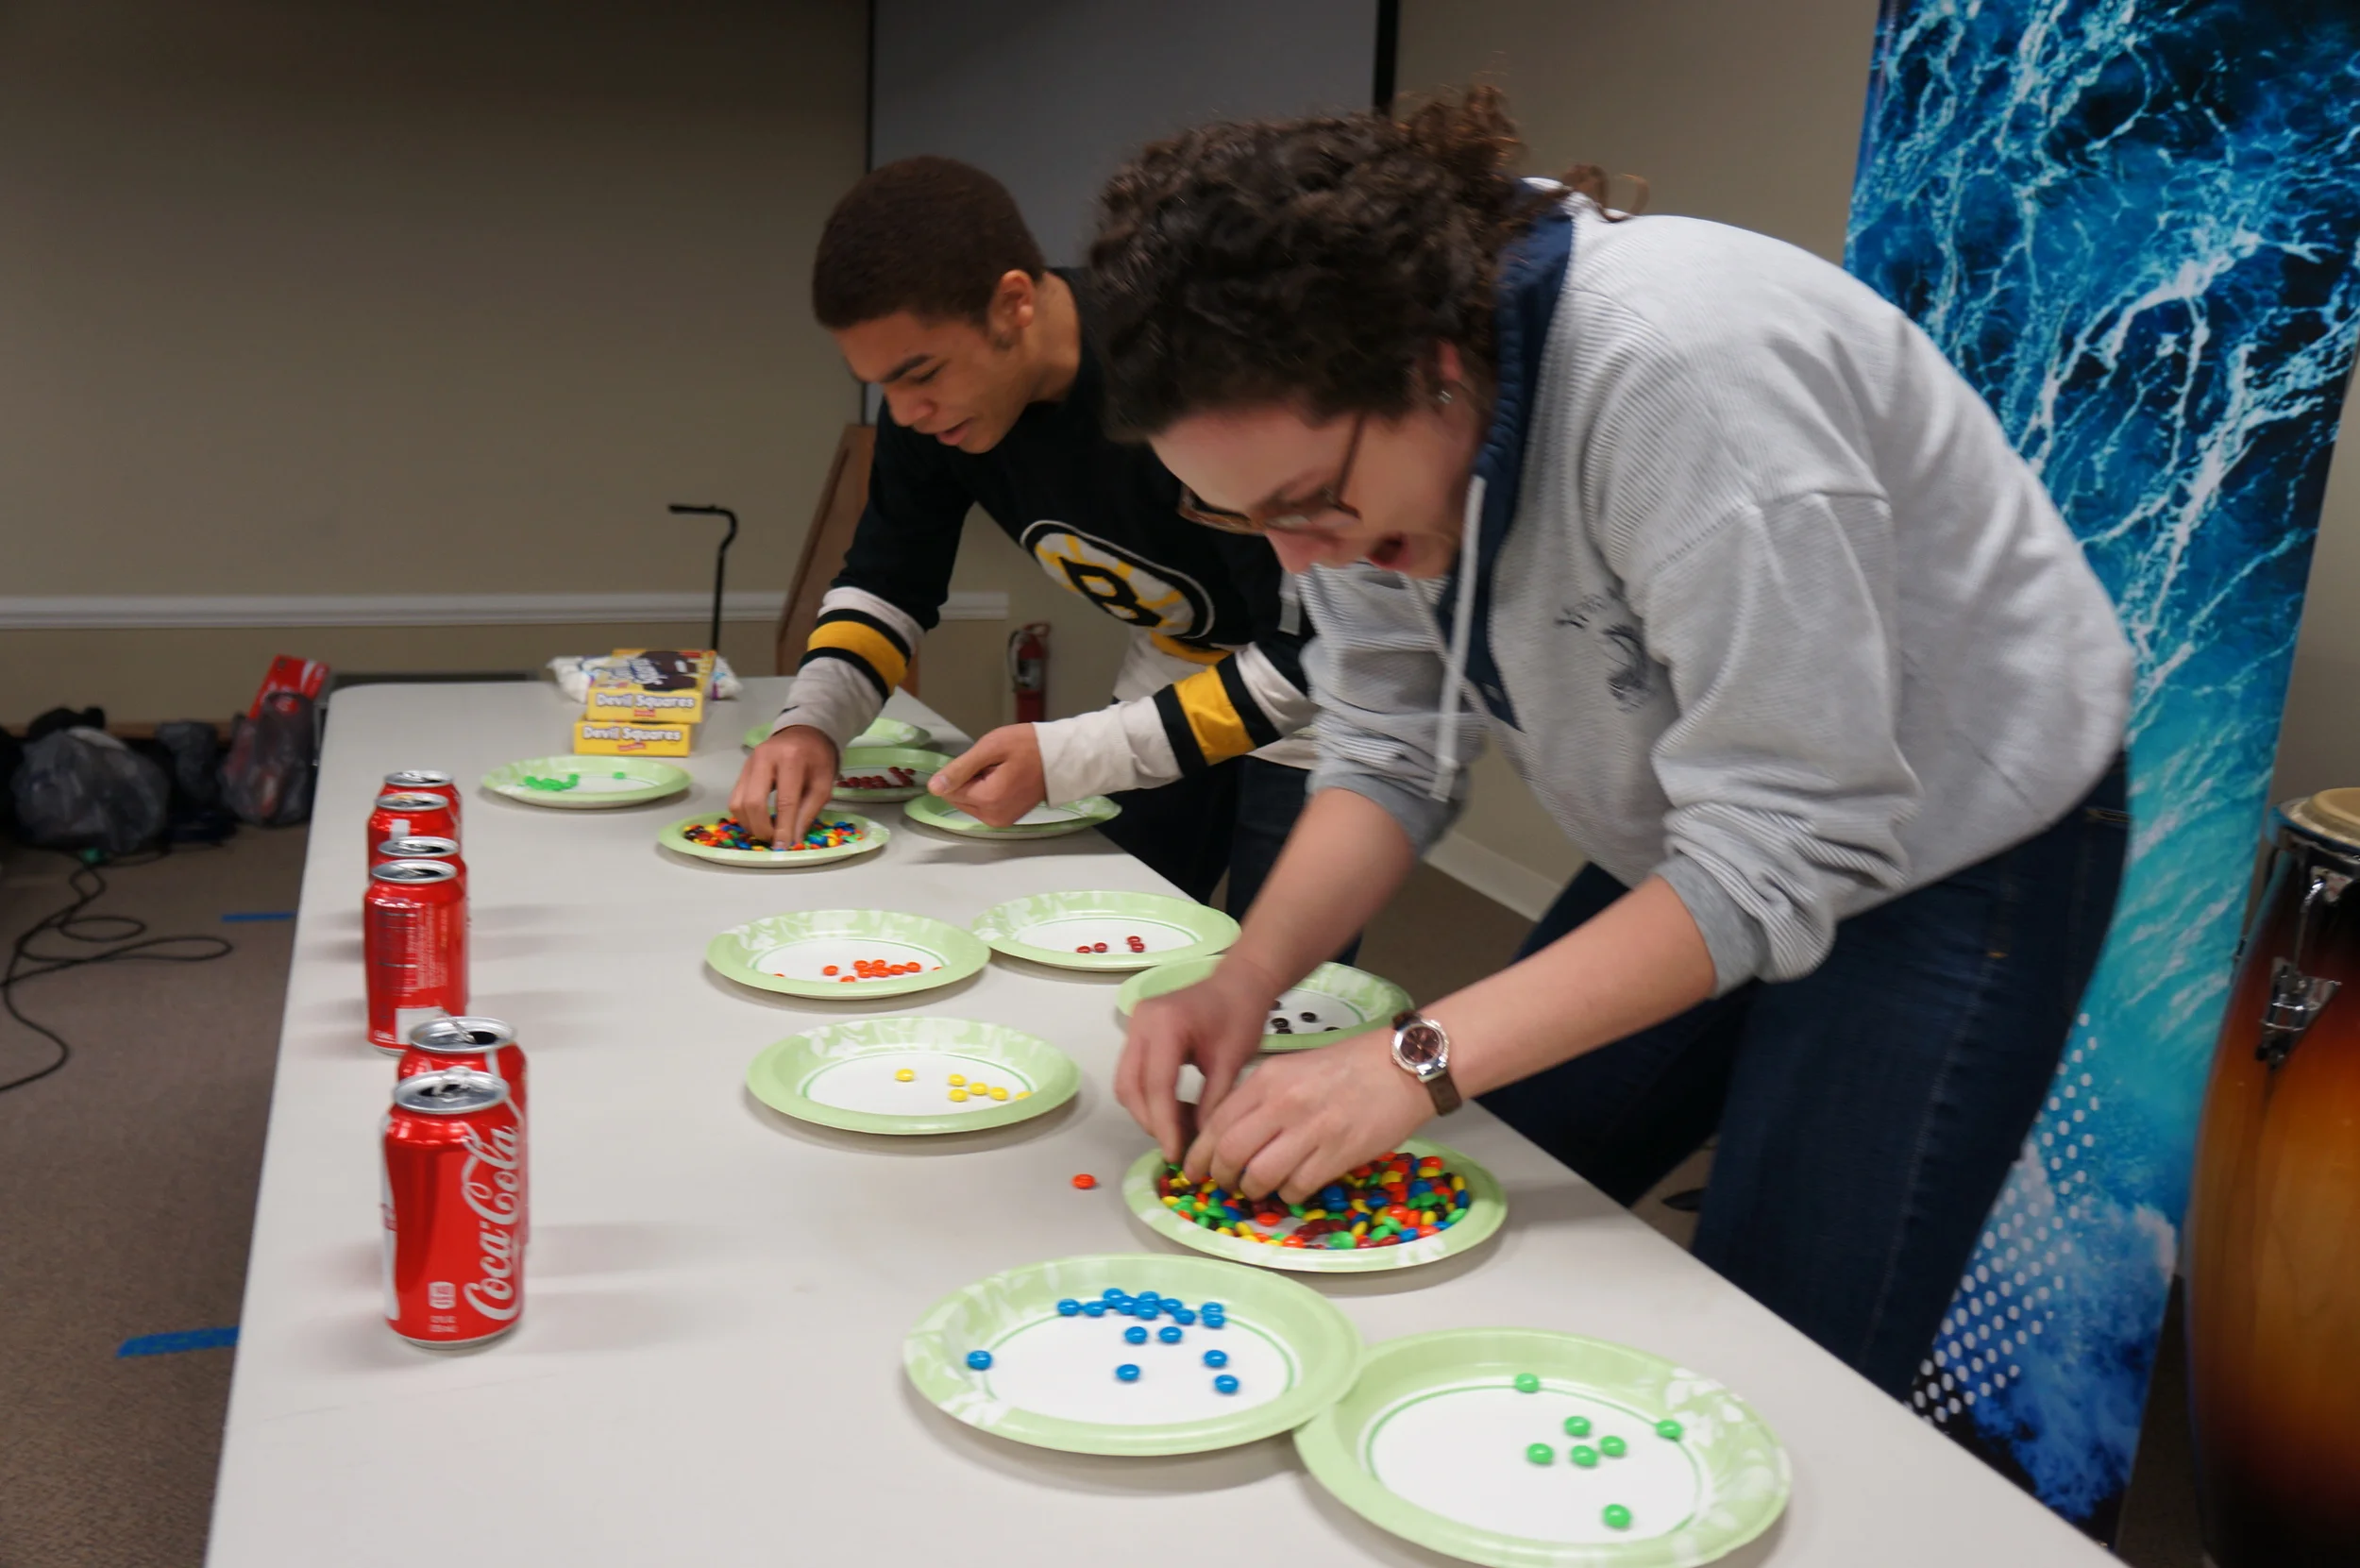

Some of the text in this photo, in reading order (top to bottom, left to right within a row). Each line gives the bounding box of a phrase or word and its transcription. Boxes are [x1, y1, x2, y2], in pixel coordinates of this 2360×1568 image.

[595, 692, 696, 711] Devil Squares
[582, 725, 682, 743] Devil Squares
